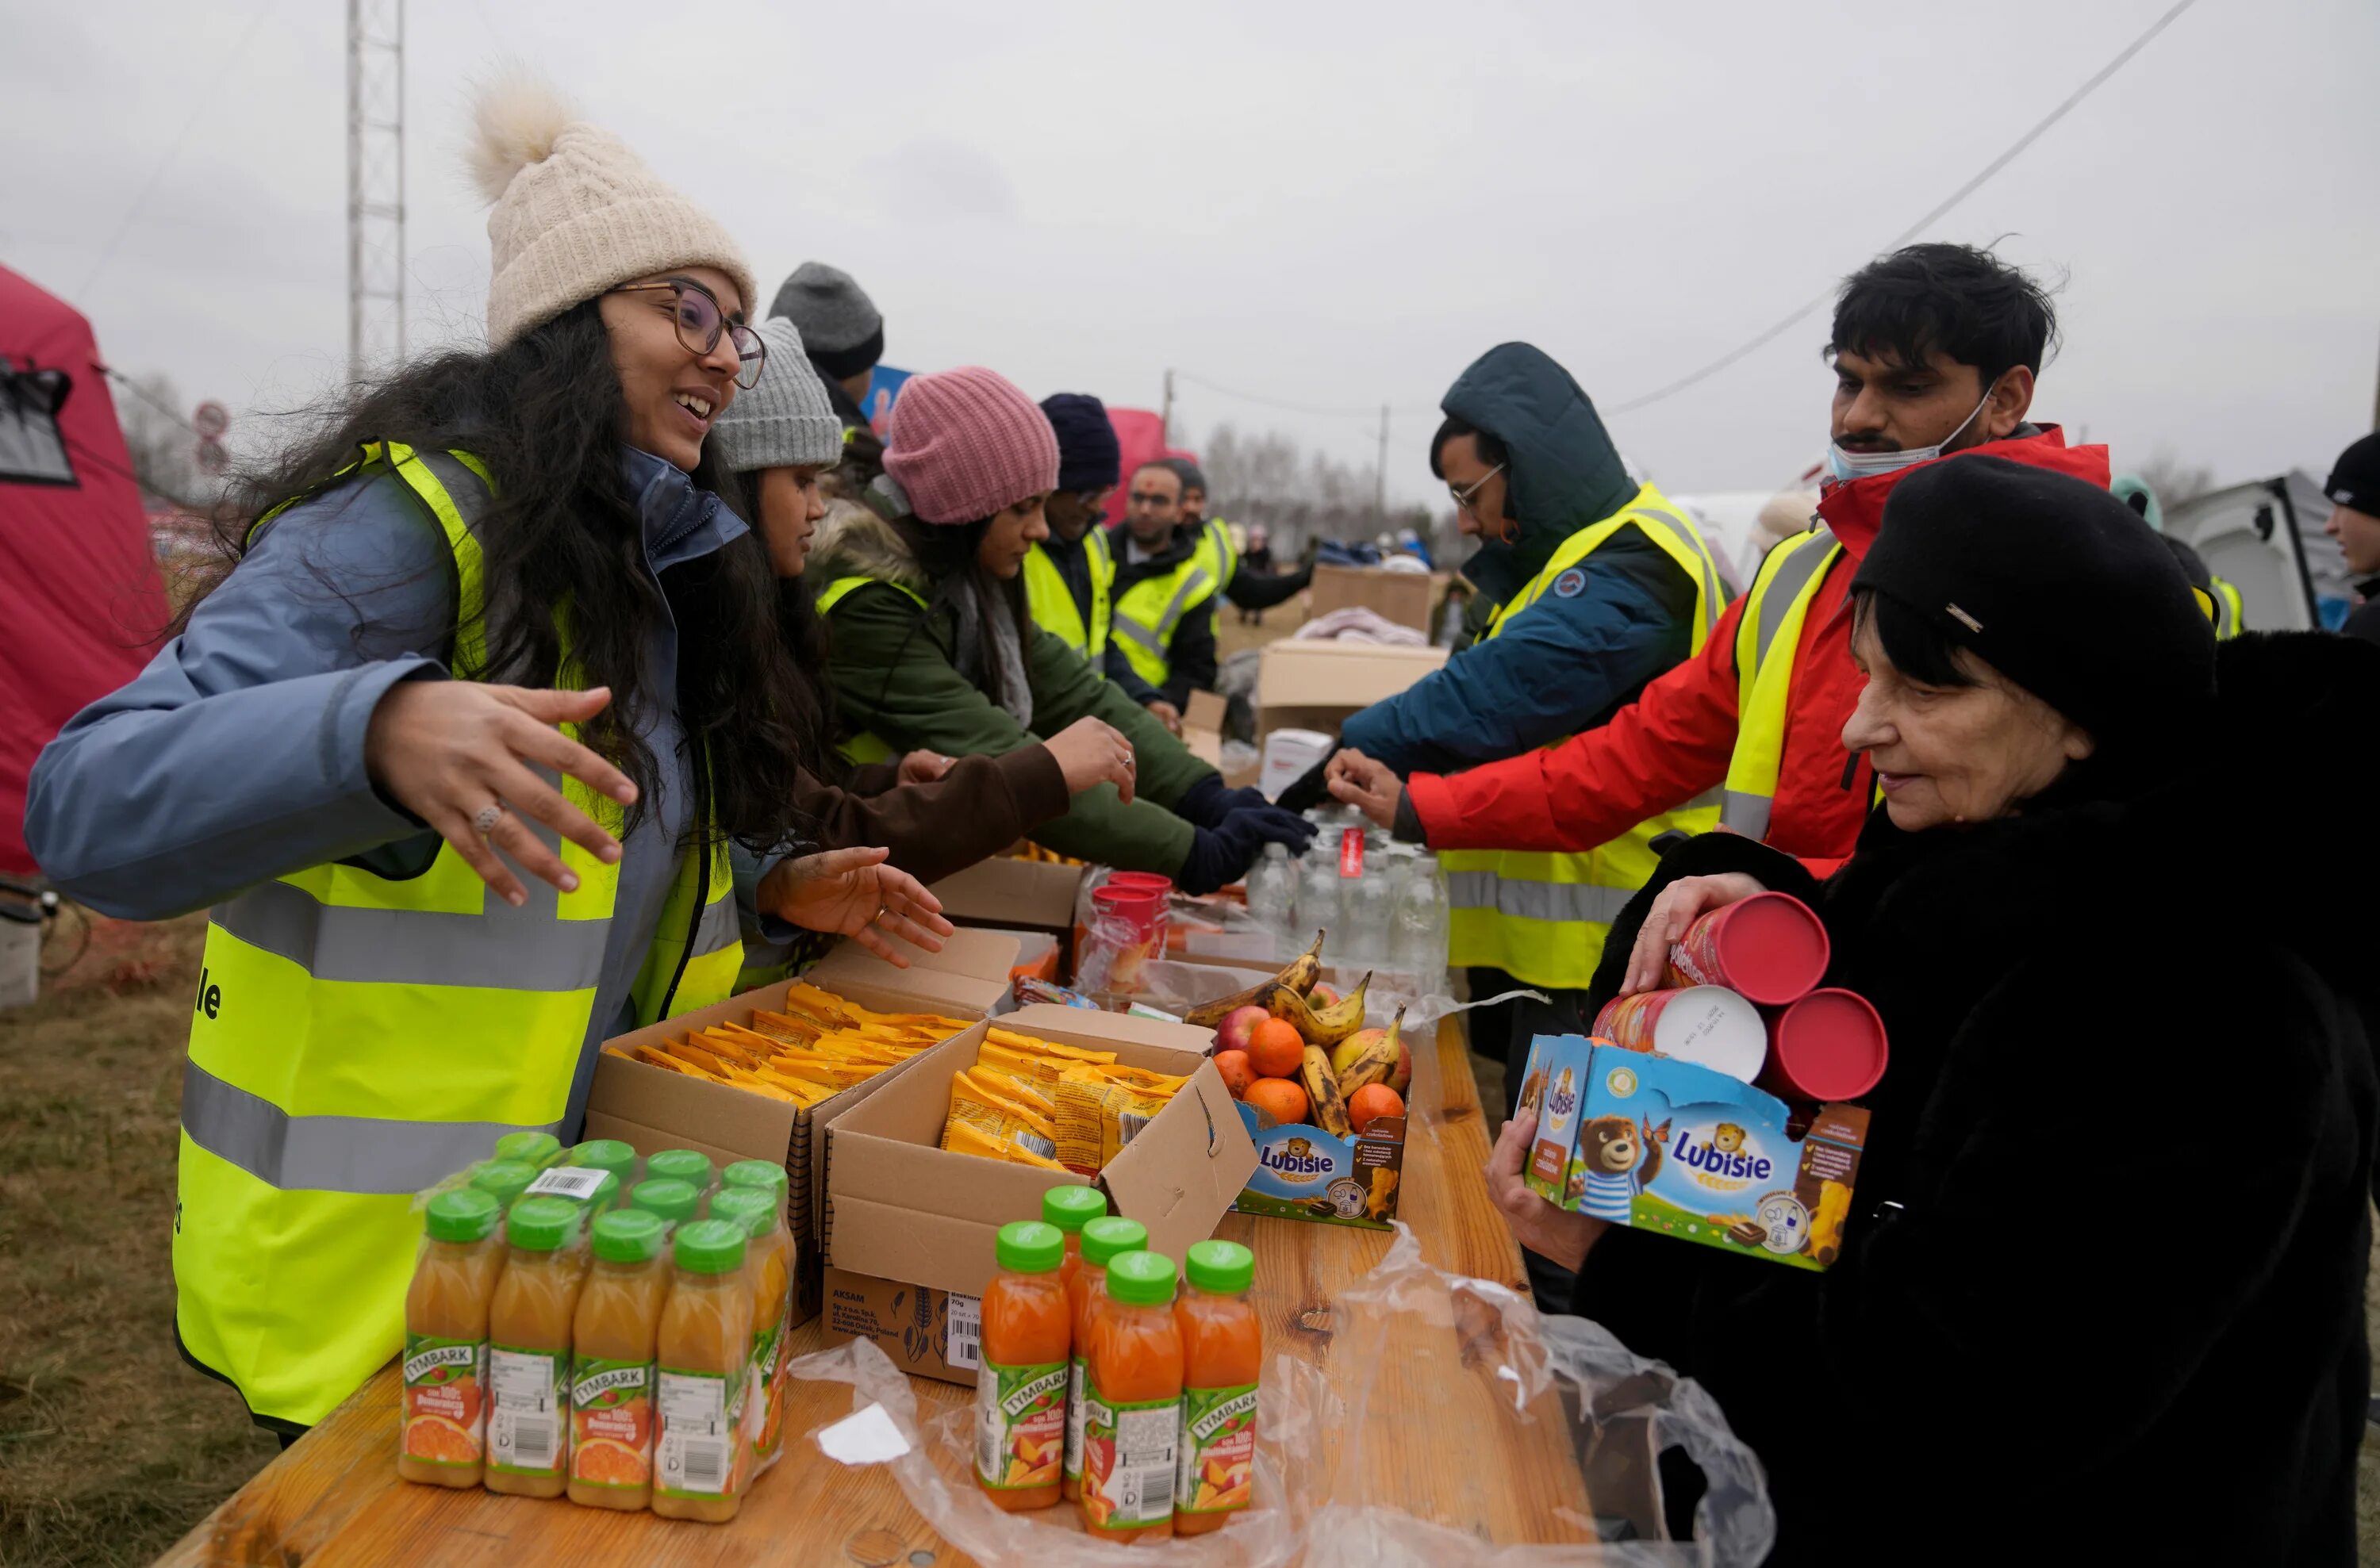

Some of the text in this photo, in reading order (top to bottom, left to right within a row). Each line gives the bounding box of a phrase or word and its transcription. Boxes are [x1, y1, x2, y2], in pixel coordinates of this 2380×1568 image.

[1549, 1080, 1575, 1115] Lubisie
[1261, 1146, 1334, 1173] Lubisie
[1673, 1131, 1771, 1179] Lubisie
[833, 1290, 865, 1304] AKSAM
[952, 1299, 964, 1308] 70g
[876, 1327, 900, 1339] Poland
[405, 1348, 469, 1377] TYMBARK
[576, 1371, 640, 1401] TYMBARK
[1198, 1392, 1257, 1434] TYMBARK
